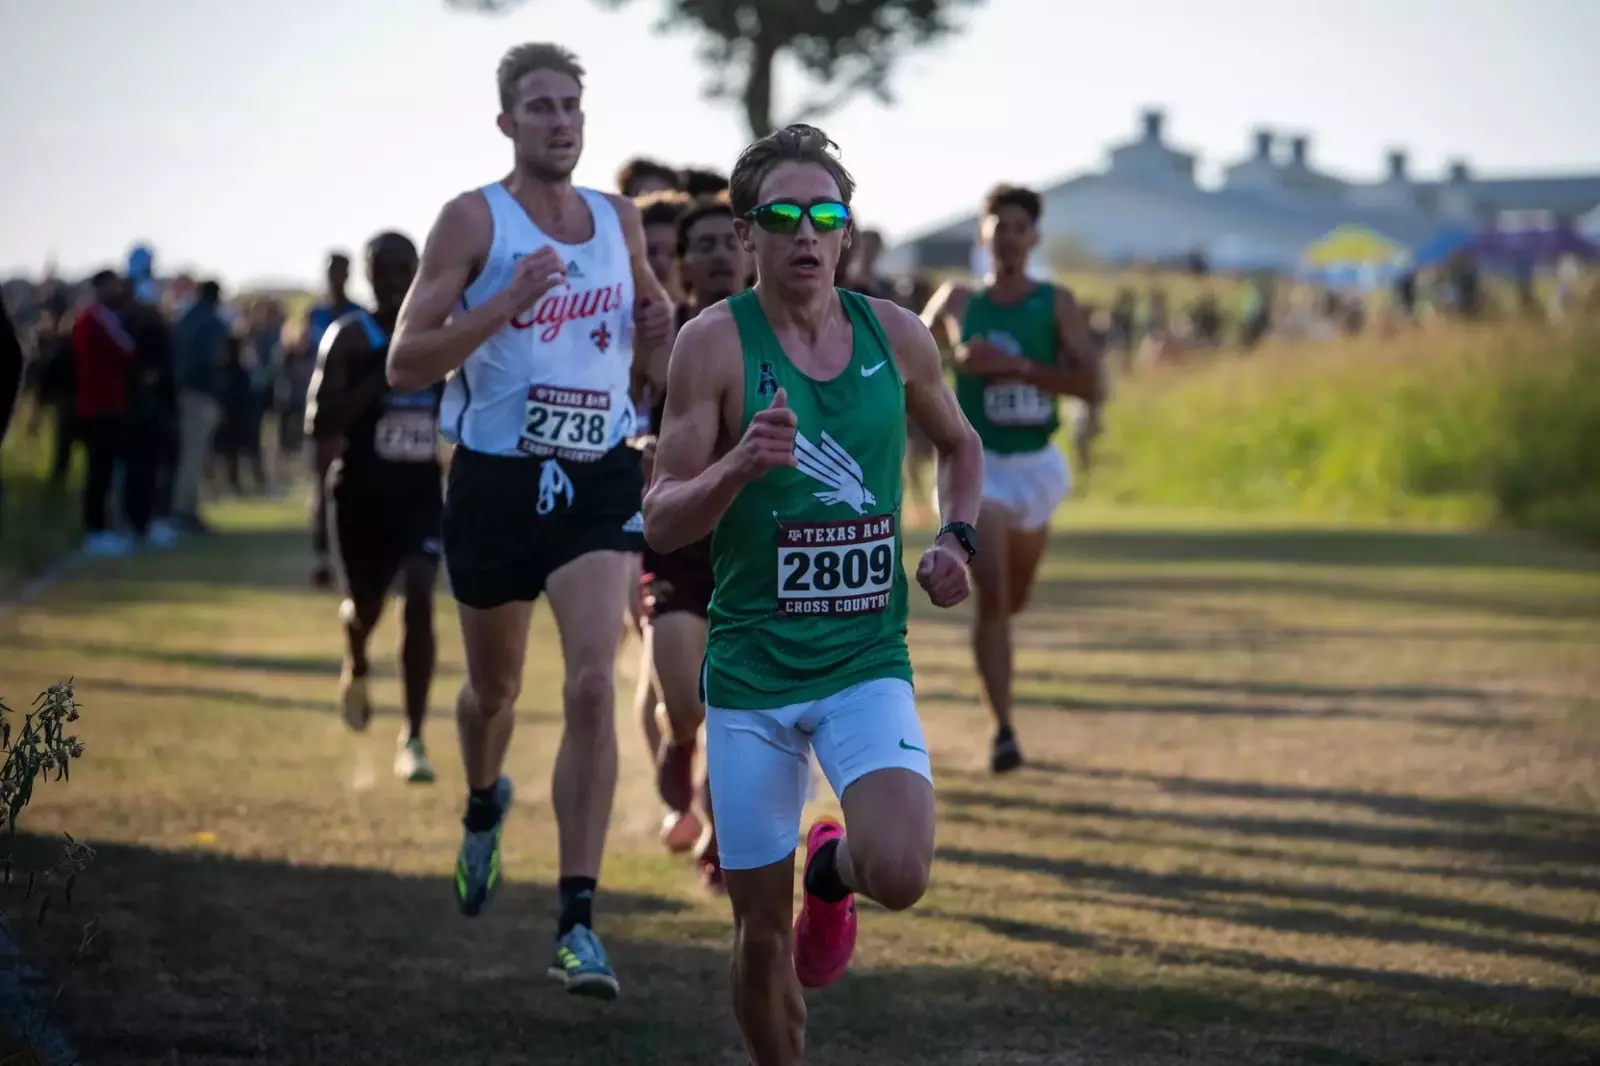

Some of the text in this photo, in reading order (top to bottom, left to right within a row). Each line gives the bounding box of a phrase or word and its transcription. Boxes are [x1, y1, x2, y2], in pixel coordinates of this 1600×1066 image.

[526, 405, 605, 445] 2738
[803, 526, 857, 543] TEXAS
[863, 519, 890, 539] A&M
[783, 544, 892, 591] 2809
[786, 600, 830, 613] CROSS
